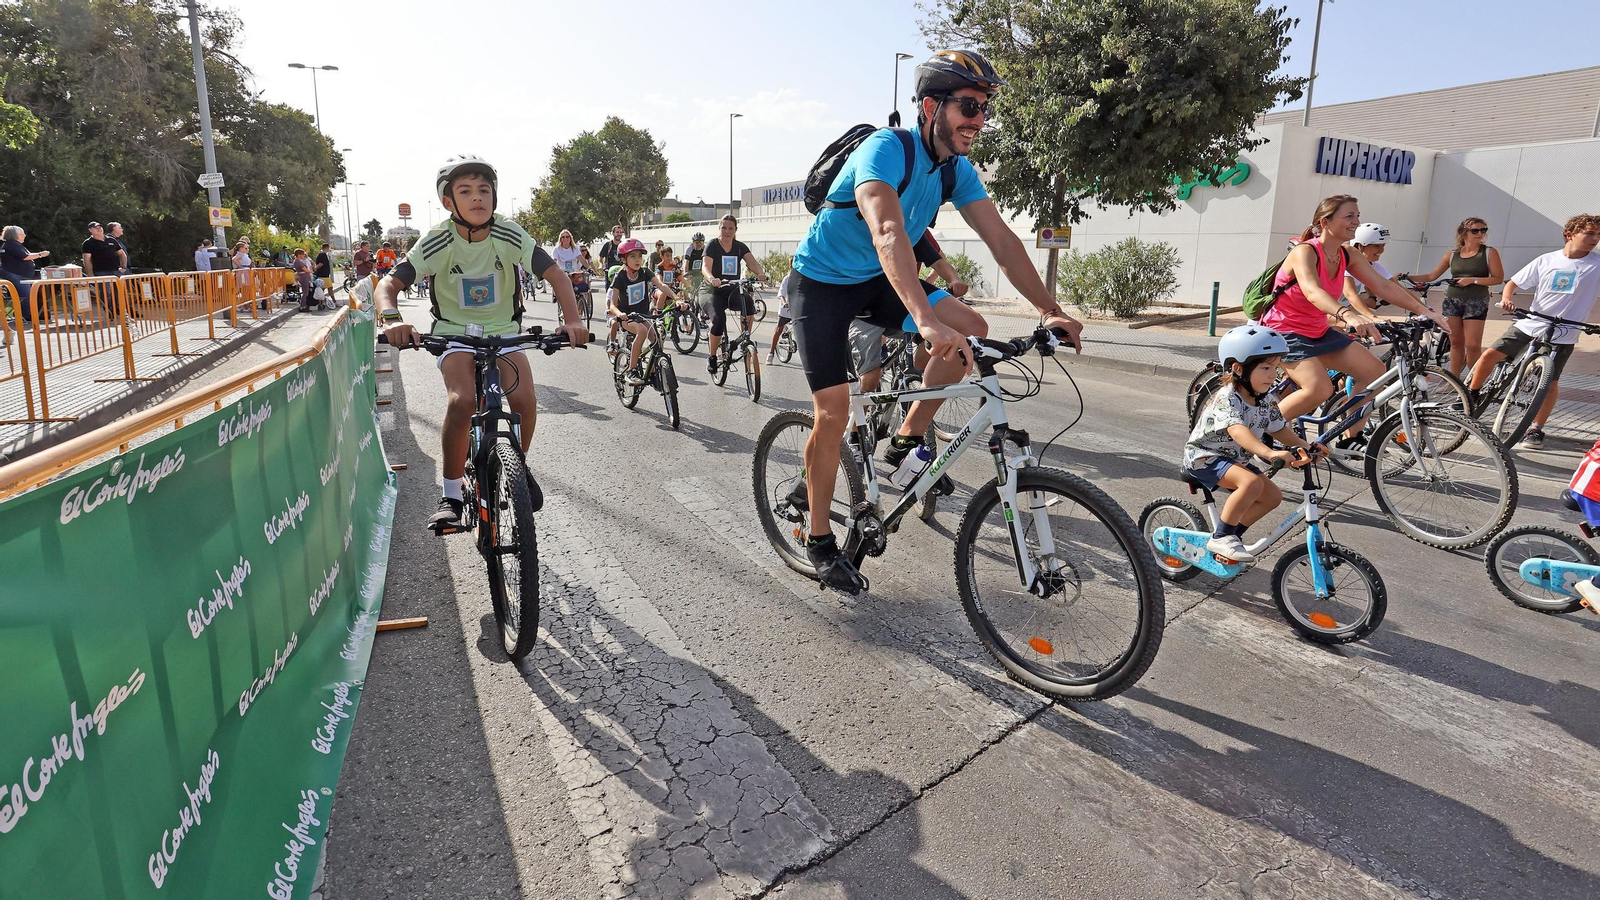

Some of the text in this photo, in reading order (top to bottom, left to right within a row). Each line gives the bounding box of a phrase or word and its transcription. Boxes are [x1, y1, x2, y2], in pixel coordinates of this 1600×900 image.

[761, 184, 806, 203] HIPERCOR
[1316, 136, 1416, 185] HIPERCOR
[218, 399, 272, 446] El Corte Inglés
[929, 425, 972, 477] ROCKRIDER
[60, 446, 185, 525] El Corte Inglés
[264, 490, 309, 545] El Corte Inglés
[187, 555, 251, 639] El Corte Inglés
[239, 631, 297, 717] El Corte Inglés
[0, 667, 146, 834] El Corte Inglés
[311, 681, 353, 755] El Corte Inglés
[148, 748, 219, 889] El Corte Inglés
[267, 789, 321, 900] El Corte Inglés
